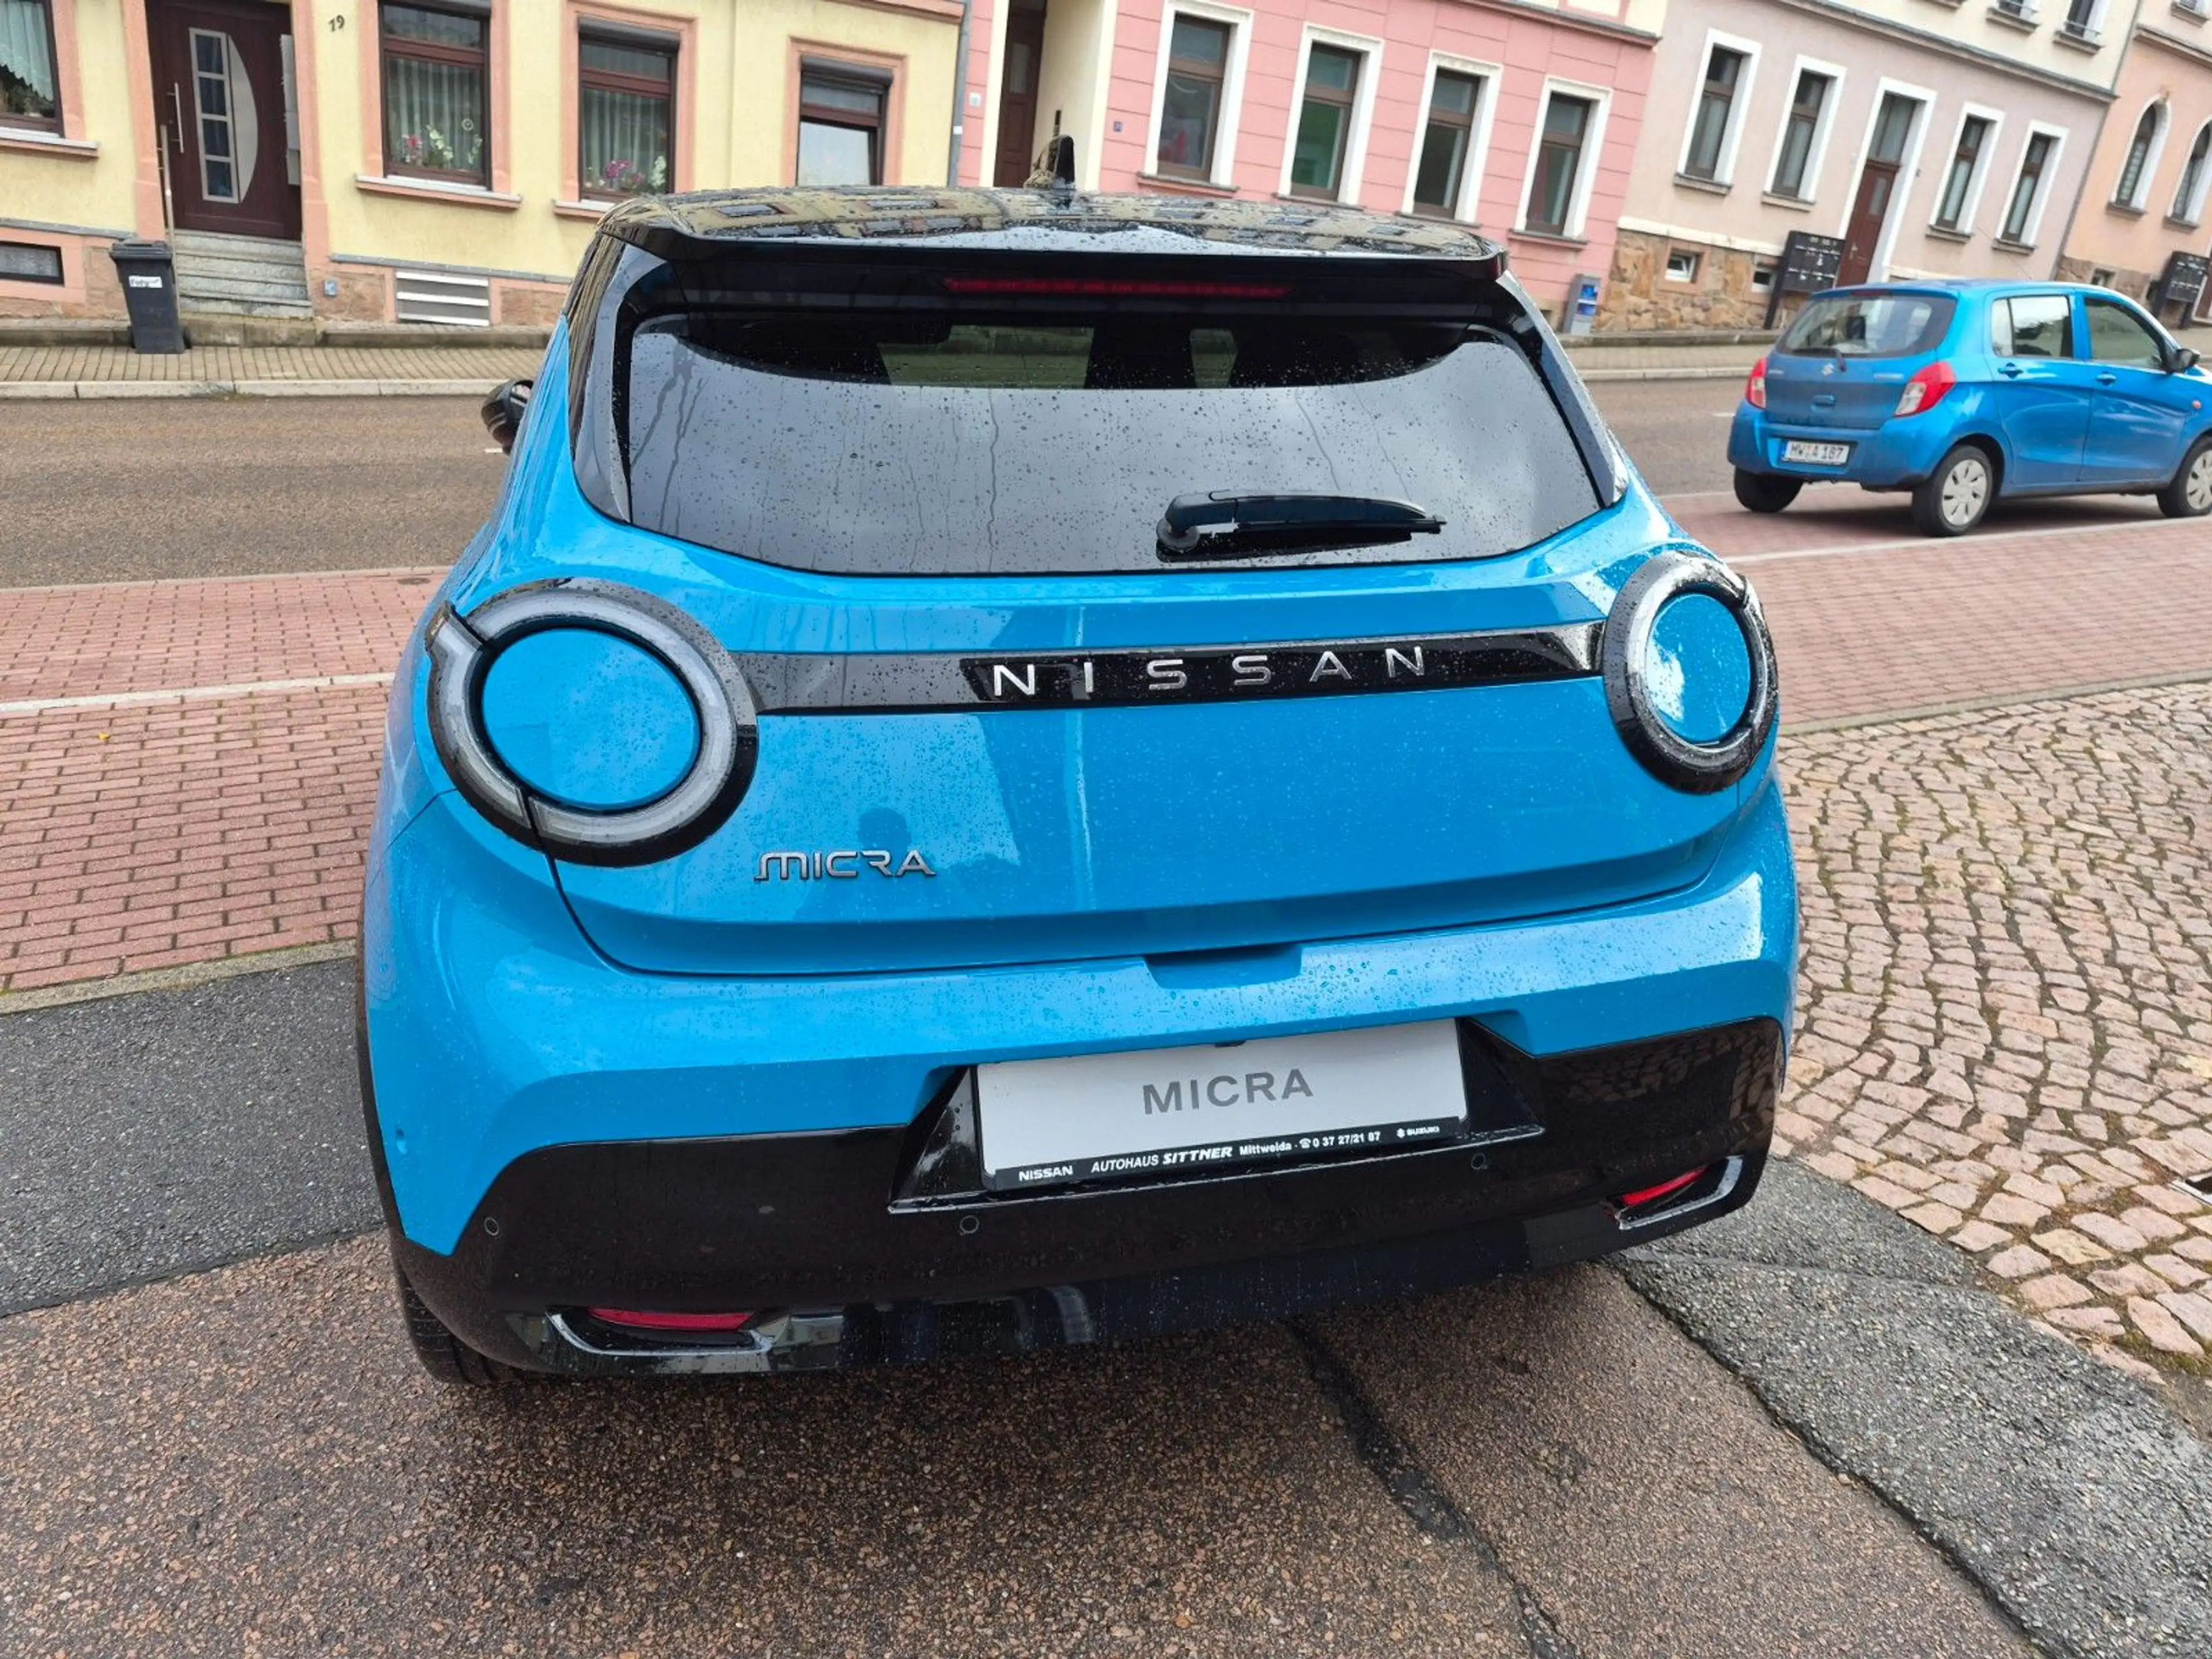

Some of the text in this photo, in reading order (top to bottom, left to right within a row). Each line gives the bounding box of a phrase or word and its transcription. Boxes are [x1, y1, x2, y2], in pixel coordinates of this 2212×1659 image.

[328, 15, 345, 32] 19
[993, 646, 1425, 696] NISSAN
[754, 850, 936, 882] MICRA
[1143, 1069, 1313, 1115] MICRA
[1019, 1165, 1073, 1181] NISSAN
[1091, 1154, 1159, 1173] AUTOHAUS
[1162, 1146, 1233, 1165] SITTNER
[1239, 1141, 1292, 1156] Mittweida
